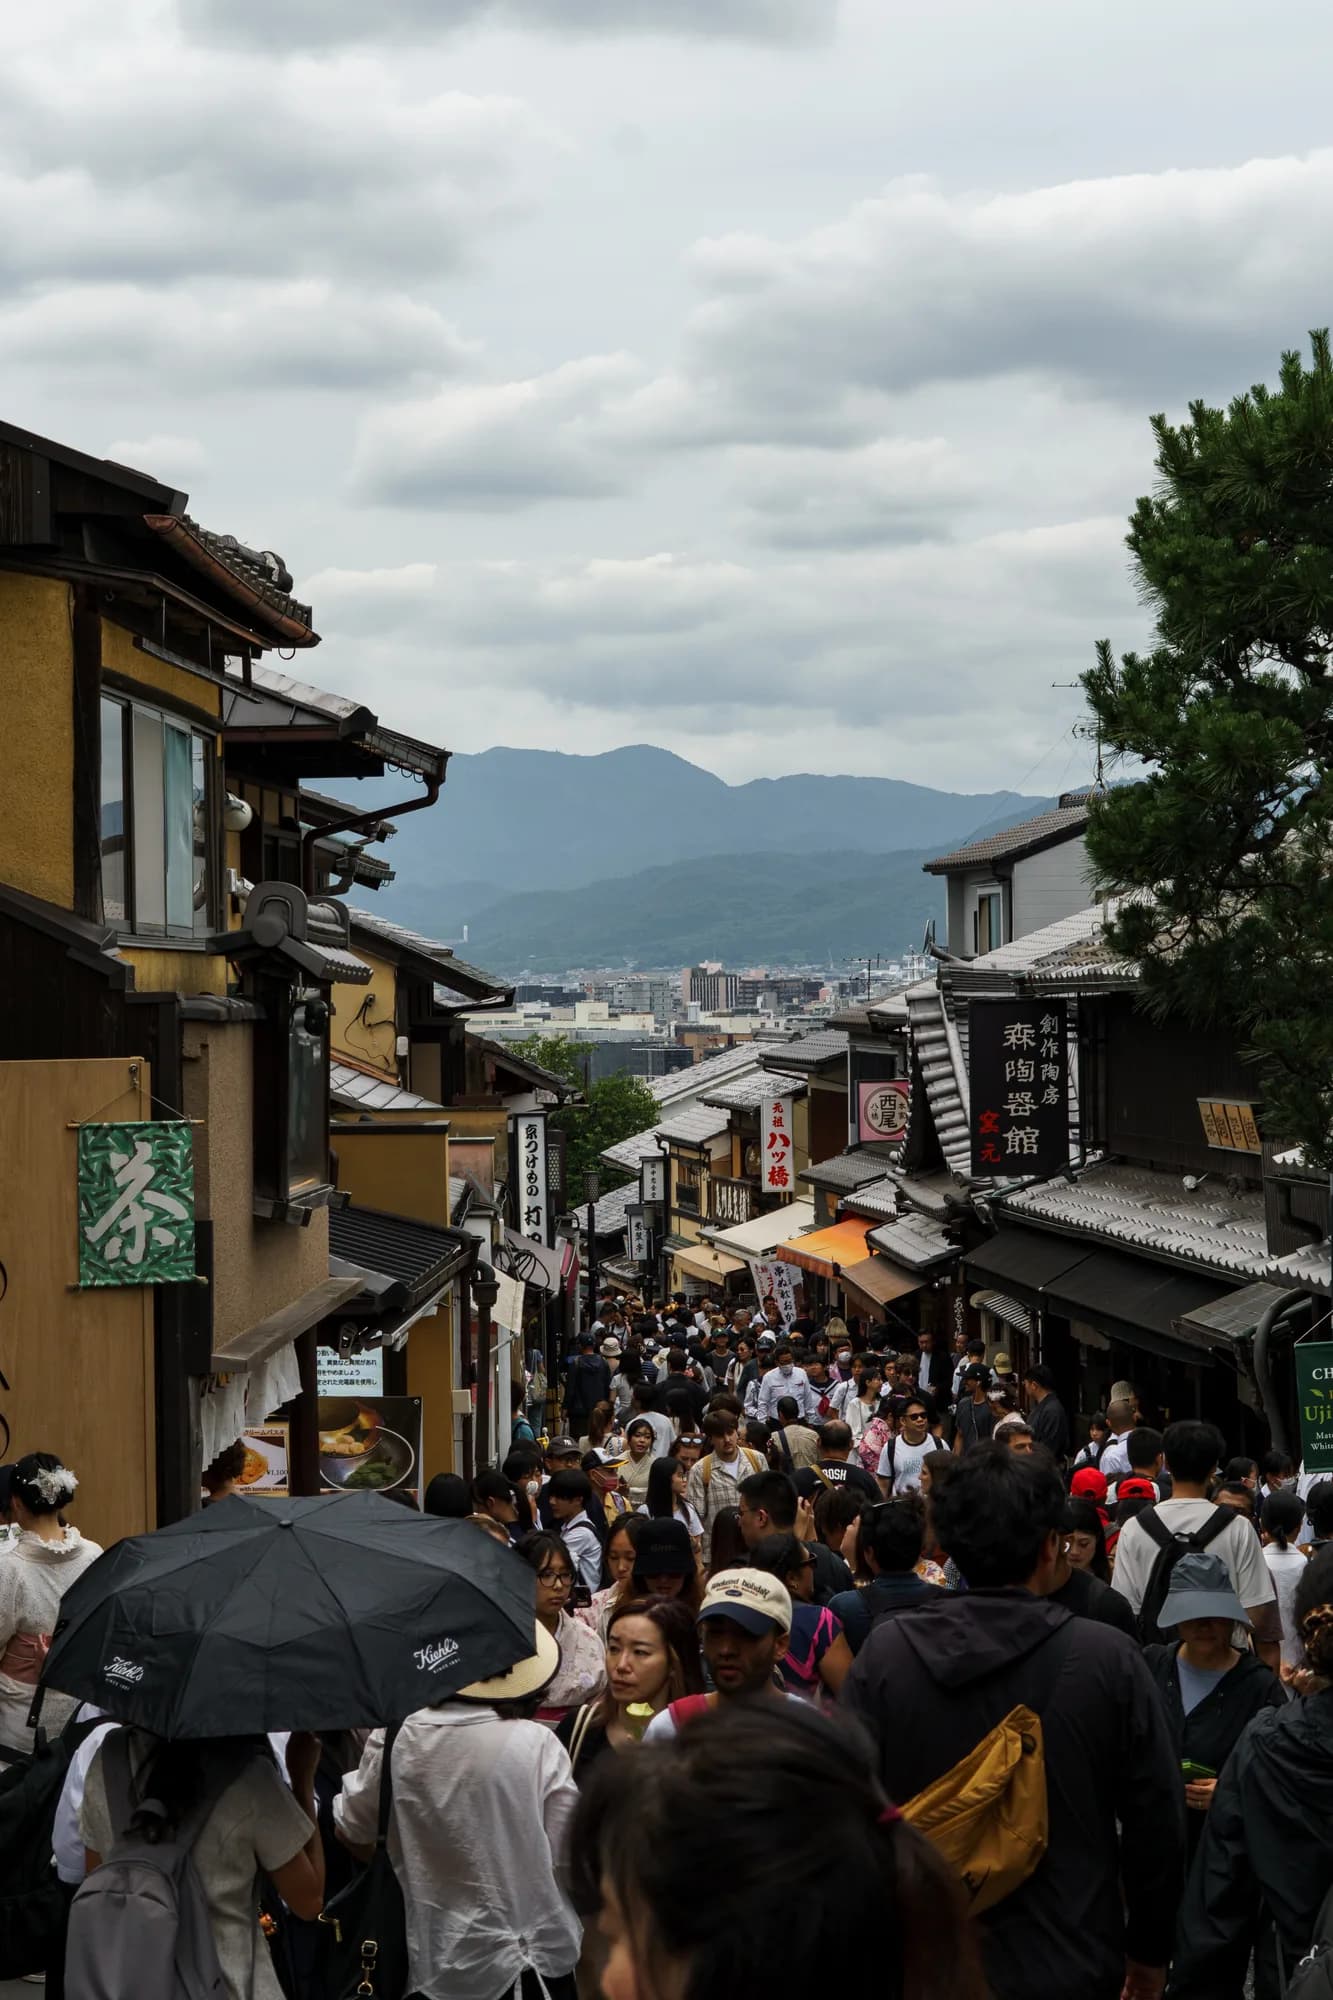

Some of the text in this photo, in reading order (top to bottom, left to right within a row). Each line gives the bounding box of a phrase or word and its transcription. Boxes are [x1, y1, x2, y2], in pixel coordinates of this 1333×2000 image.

[1040, 1013, 1060, 1105] 創作陶房
[878, 1094, 898, 1129] 西尾
[1001, 1022, 1041, 1154] 森陶器館
[525, 1123, 539, 1197] 京つけもの
[86, 1141, 189, 1265] 茶
[1303, 1404, 1333, 1425] Uji
[103, 1656, 145, 1681] Kiehl's
[413, 1637, 460, 1671] Kiehl's
